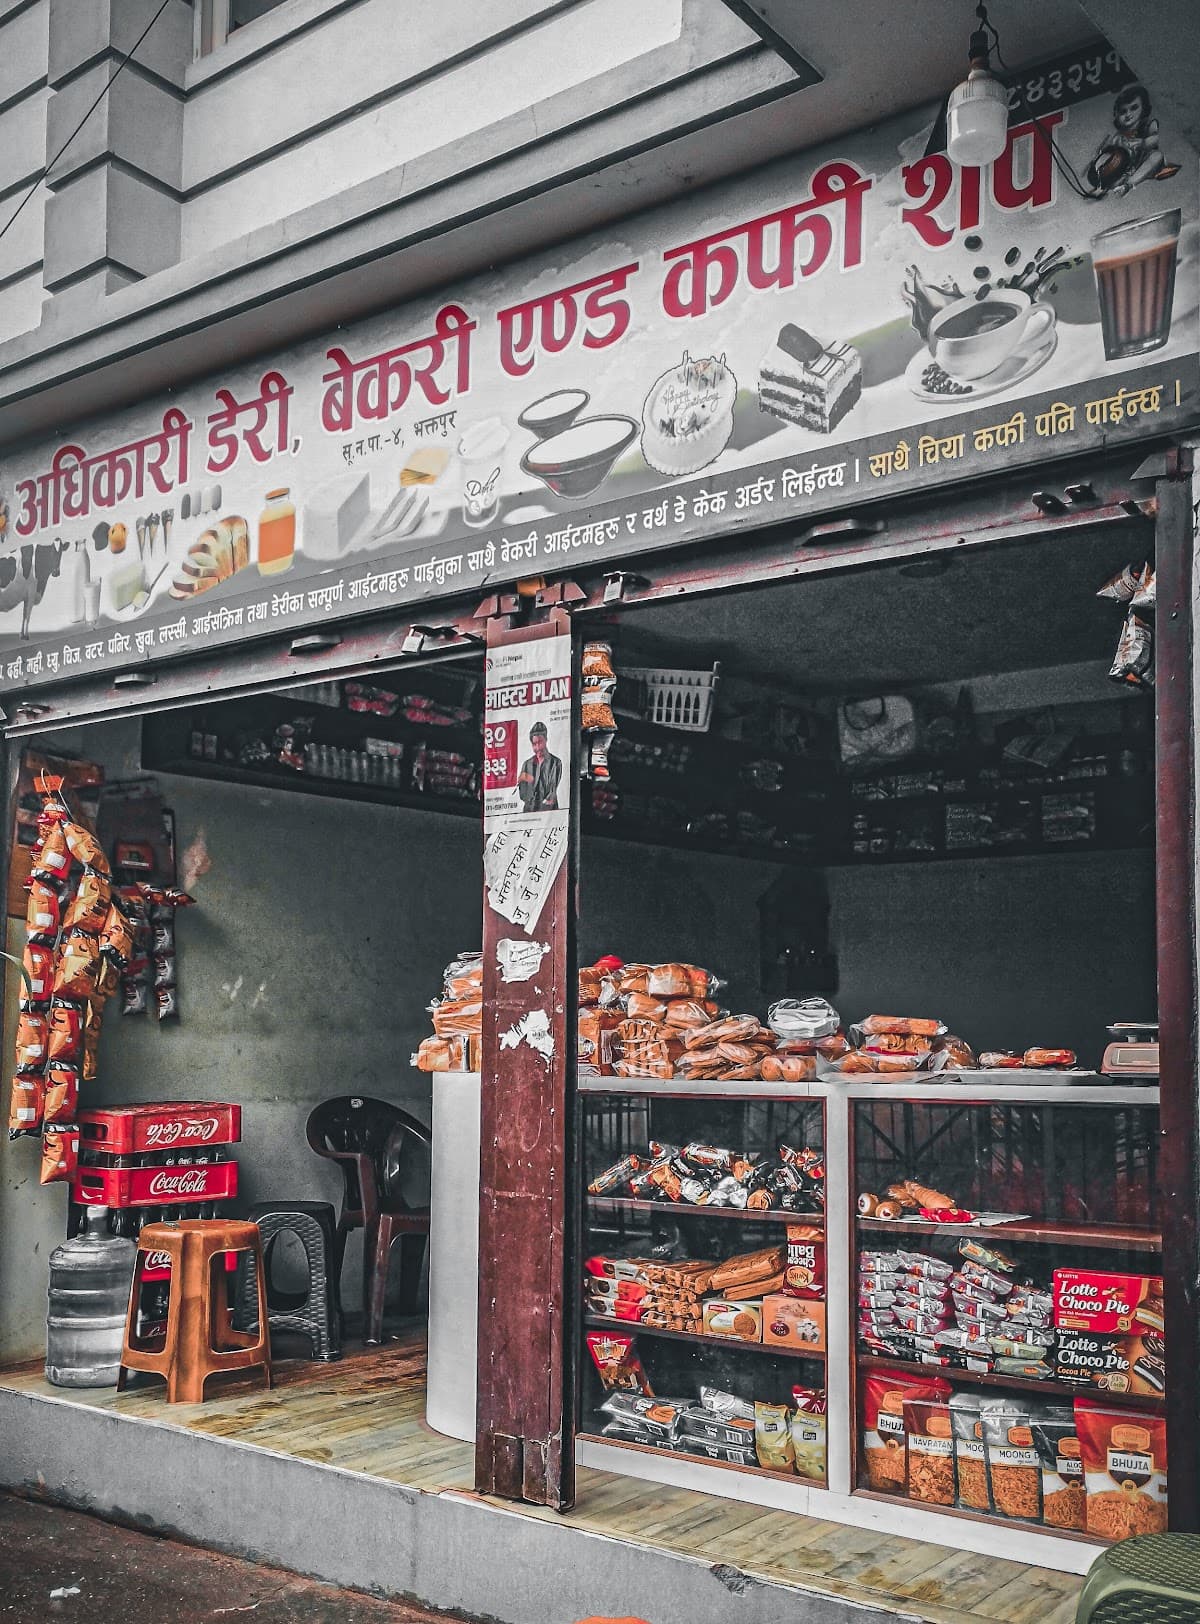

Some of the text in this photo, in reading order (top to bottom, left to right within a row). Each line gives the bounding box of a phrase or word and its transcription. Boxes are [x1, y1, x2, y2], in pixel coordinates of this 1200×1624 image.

[14, 407, 194, 537] अधिकारी
[322, 304, 477, 432] बेकरी
[497, 261, 639, 376] एण्ड
[662, 163, 873, 318] कफी
[413, 410, 458, 437] भक्तपुर
[247, 602, 268, 624] तथा
[271, 592, 304, 617] डेरीका
[308, 579, 344, 612] सम्पूर्ण
[467, 540, 496, 571] साथै
[500, 530, 538, 563] बेकरी
[625, 512, 637, 534] र
[673, 495, 687, 523] डे
[692, 490, 728, 518] केक
[734, 475, 776, 509] अर्डर
[868, 440, 911, 477] साथै
[918, 433, 965, 467] चिया
[972, 411, 1027, 452] कफी
[1035, 402, 1077, 437] पनि
[1085, 385, 1164, 426] पाईन्छ
[532, 677, 570, 702] PLAN
[146, 1118, 218, 1145] Coca-Cola
[150, 1170, 208, 1195] Coca-Cola
[1059, 1280, 1098, 1296] Lotte
[1058, 1295, 1103, 1312] Choco
[1104, 1299, 1130, 1314] Pie
[1057, 1335, 1098, 1352] Lotte
[1057, 1349, 1130, 1370] Choco Pie
[1057, 1366, 1092, 1377] Cocoa Pie
[913, 1438, 952, 1449] NAVRATAN
[1000, 1450, 1031, 1459] MOONG
[1112, 1458, 1149, 1471] BHUJIA
